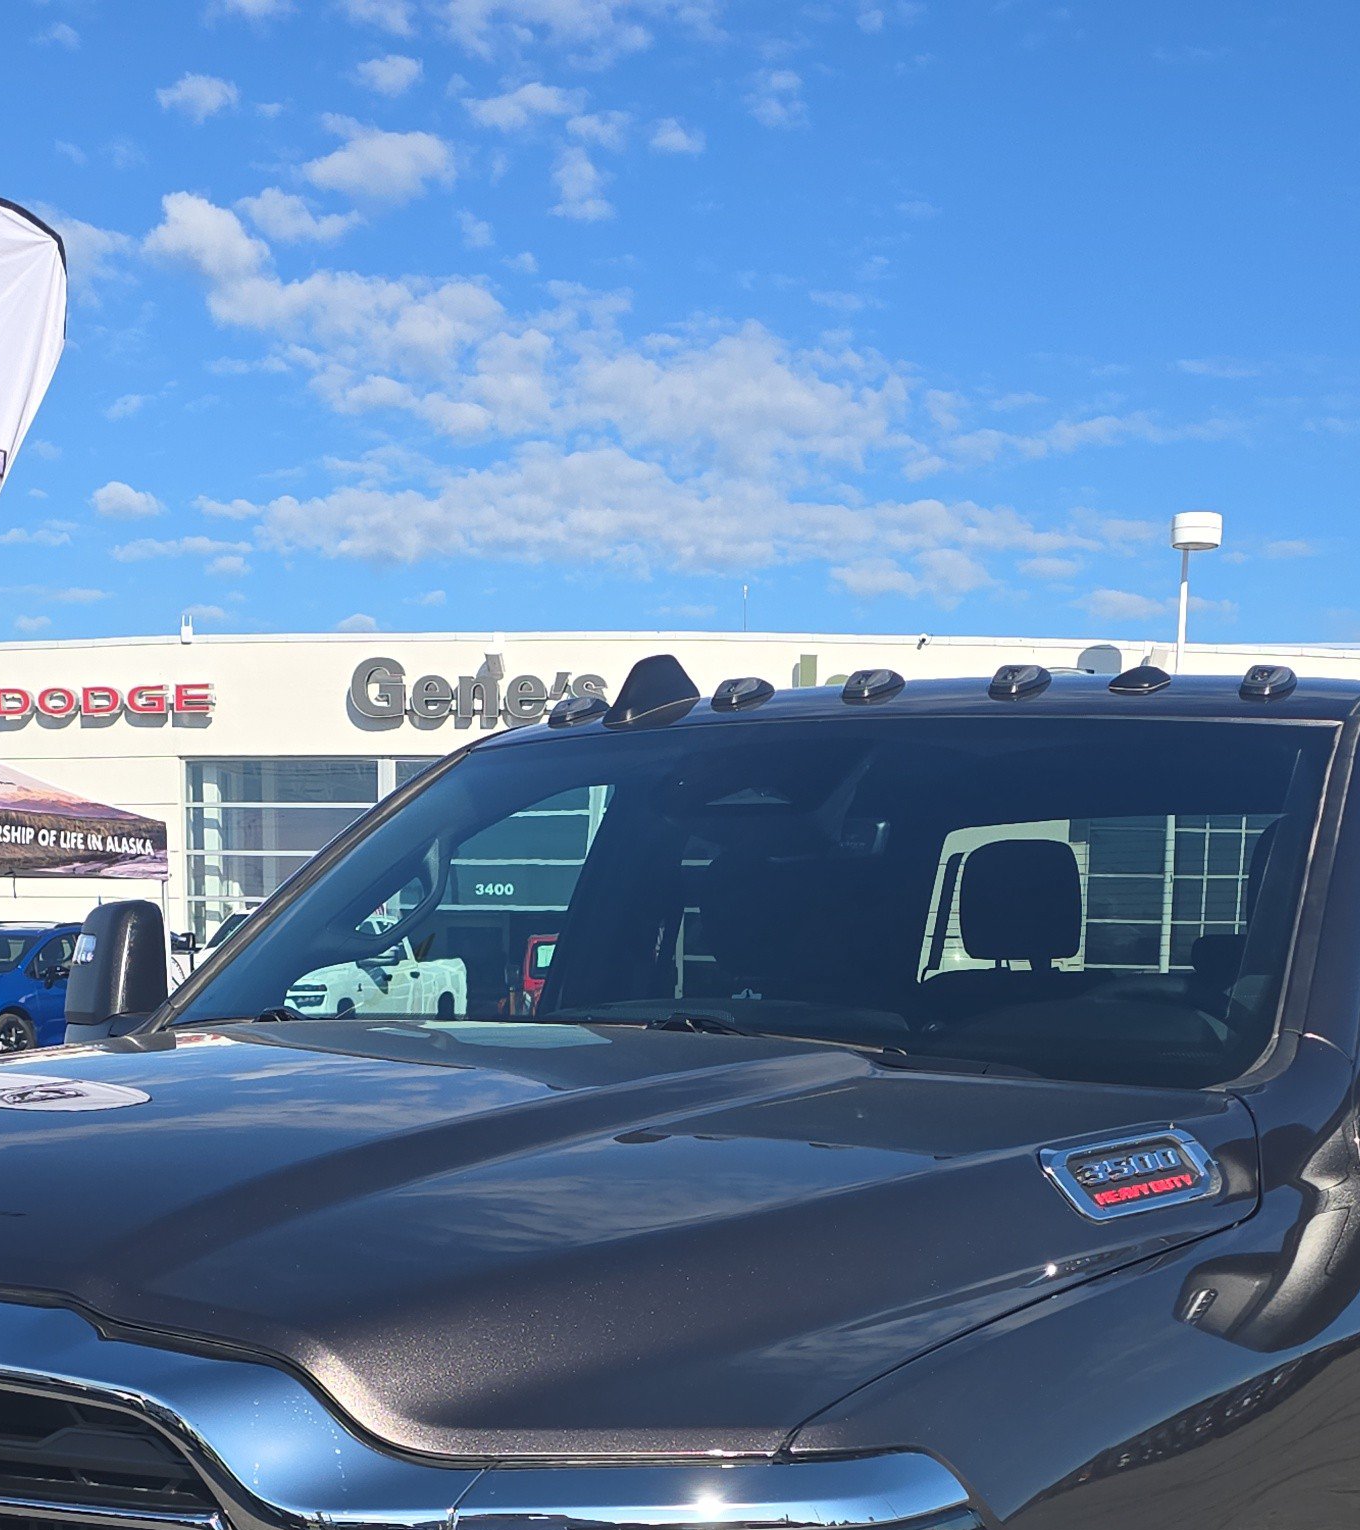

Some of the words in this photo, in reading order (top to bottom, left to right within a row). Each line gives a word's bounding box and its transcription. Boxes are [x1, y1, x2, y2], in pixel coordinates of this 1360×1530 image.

[349, 656, 608, 719] Gene's
[38, 828, 58, 847] OF
[59, 830, 85, 850] LIFE
[87, 833, 104, 851] IN
[106, 835, 155, 856] ALASKA
[475, 883, 514, 895] 3400
[1075, 1147, 1183, 1186] 3500
[1093, 1182, 1150, 1206] HEAVY
[1147, 1172, 1193, 1193] DUTY
